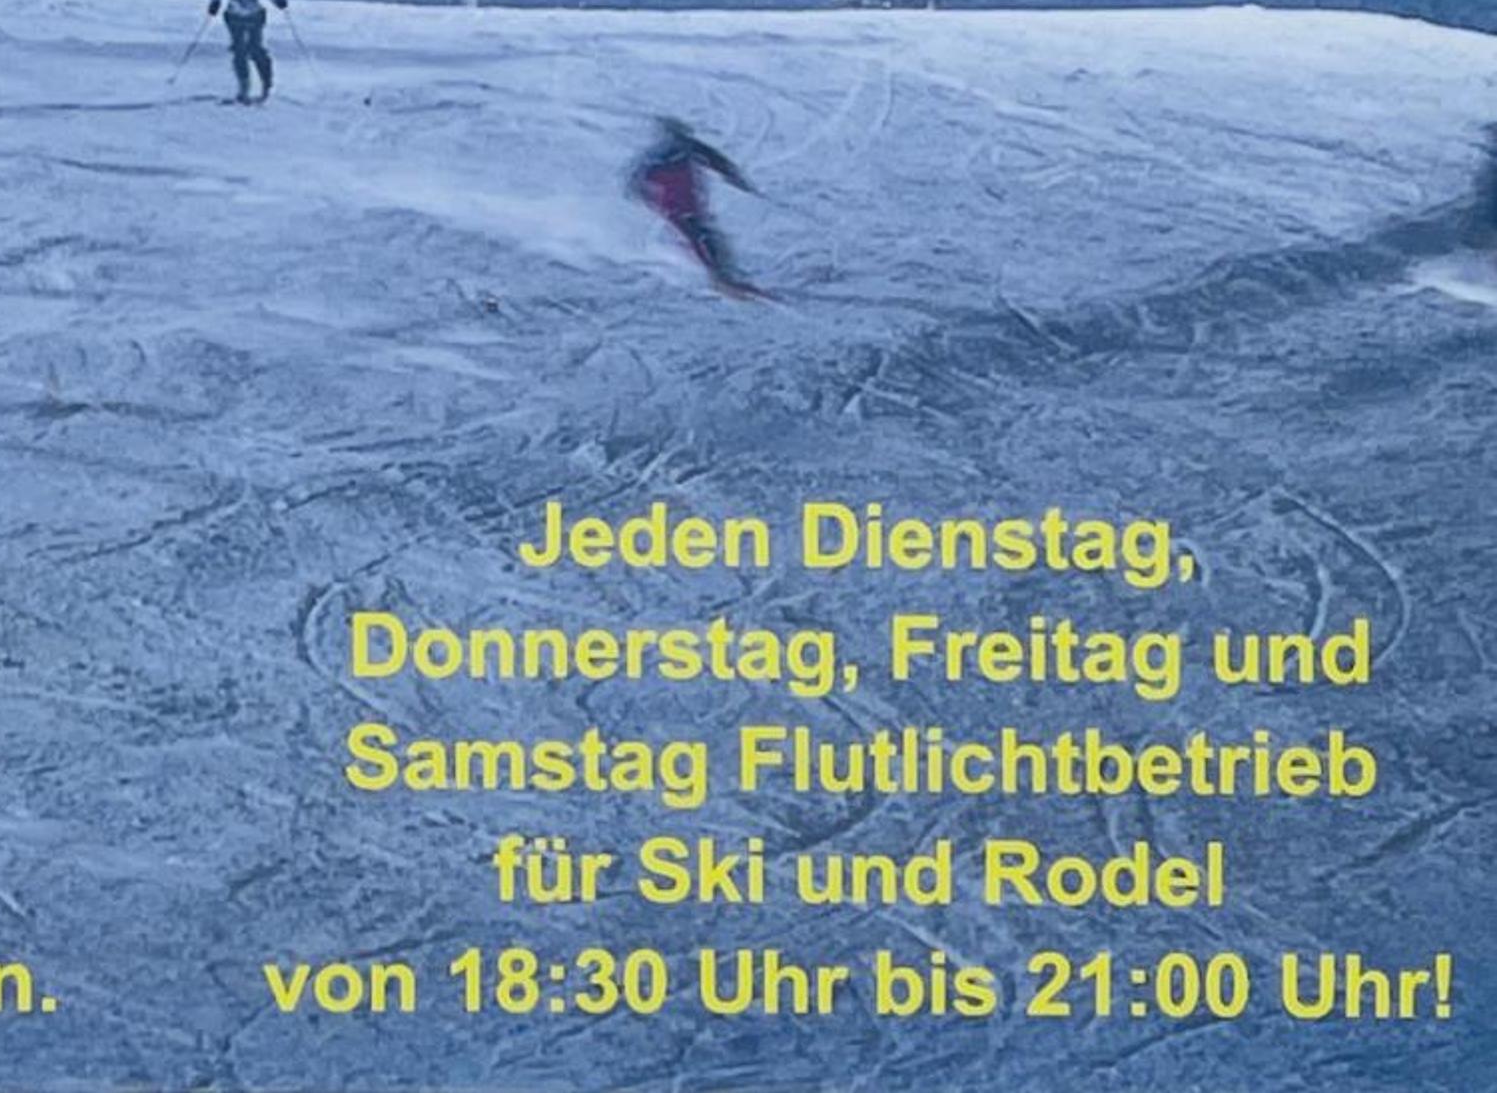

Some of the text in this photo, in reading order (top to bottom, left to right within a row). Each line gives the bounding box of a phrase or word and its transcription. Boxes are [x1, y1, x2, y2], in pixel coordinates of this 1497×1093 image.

[518, 501, 1195, 590] Jeden Dienstag,
[351, 610, 1372, 702] Donnerstag, Freitag und
[346, 722, 1377, 810] Samstag Flutlichtbetrieb
[493, 835, 1225, 907] für Ski und Rodel
[264, 947, 1453, 1019] von 18:30 Uhr bis 21:00 Uhr!
